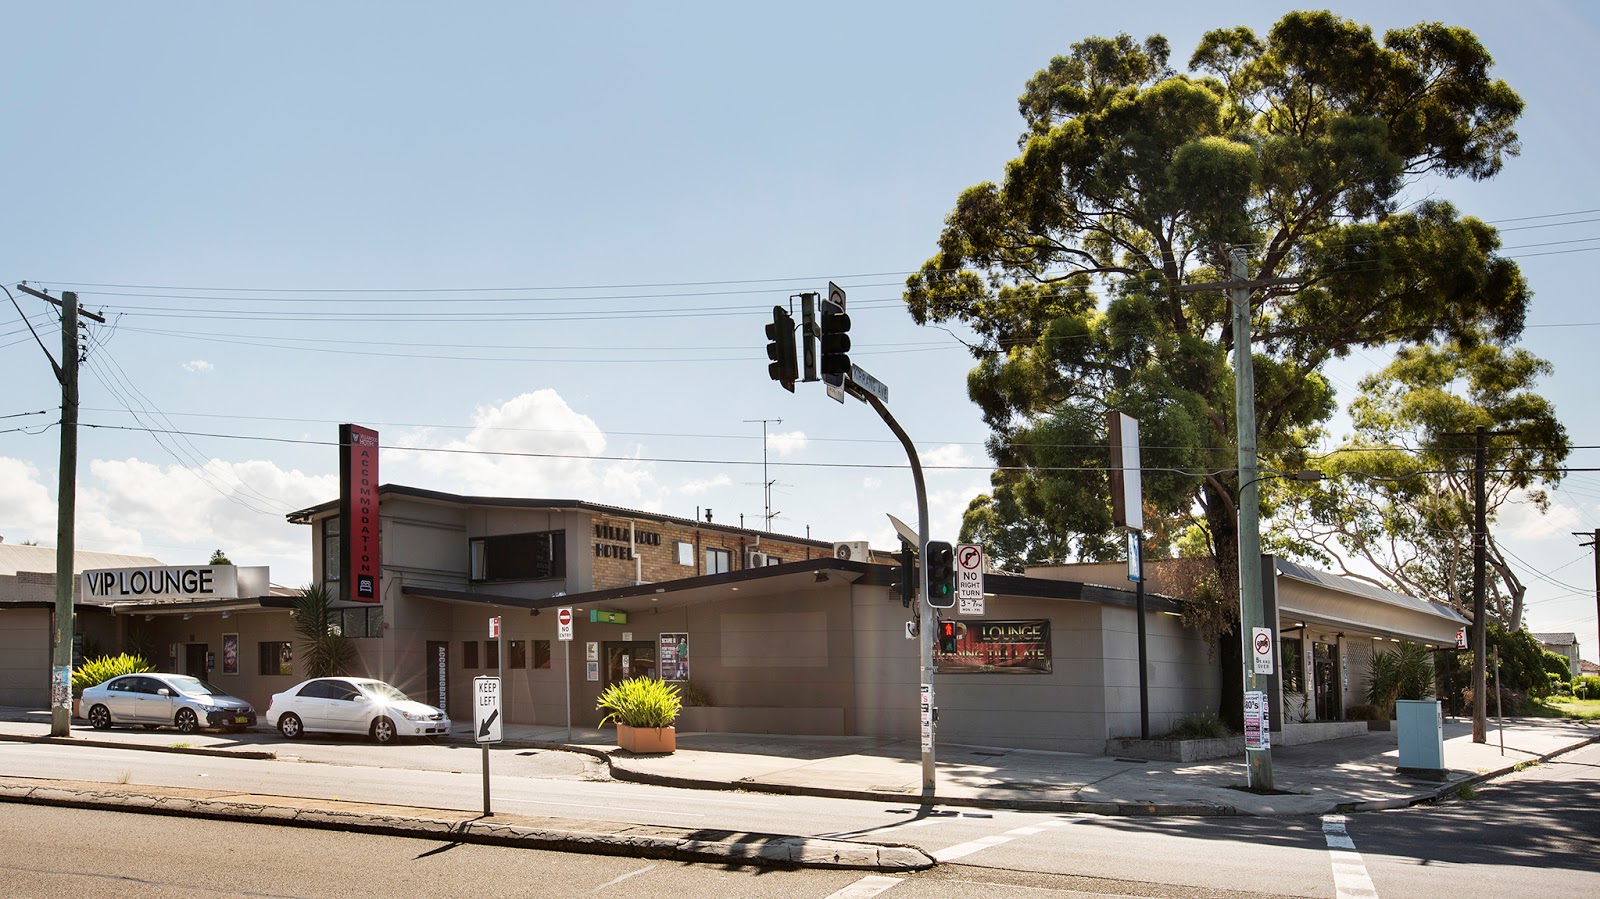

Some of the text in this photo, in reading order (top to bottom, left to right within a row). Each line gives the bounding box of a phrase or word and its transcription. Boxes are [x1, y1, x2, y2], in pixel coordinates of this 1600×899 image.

[877, 383, 888, 400] AVE
[360, 450, 371, 572] ACCOMMODATION
[595, 543, 634, 560] HOTEL
[87, 569, 215, 596] VIP LOUNGE
[963, 572, 977, 581] NO
[960, 581, 980, 589] RIGHT
[982, 625, 1041, 640] LOUNGE
[987, 649, 1011, 660] TILL
[1015, 649, 1045, 660] LATE
[479, 682, 496, 693] KEEP
[479, 696, 496, 707] LEFT
